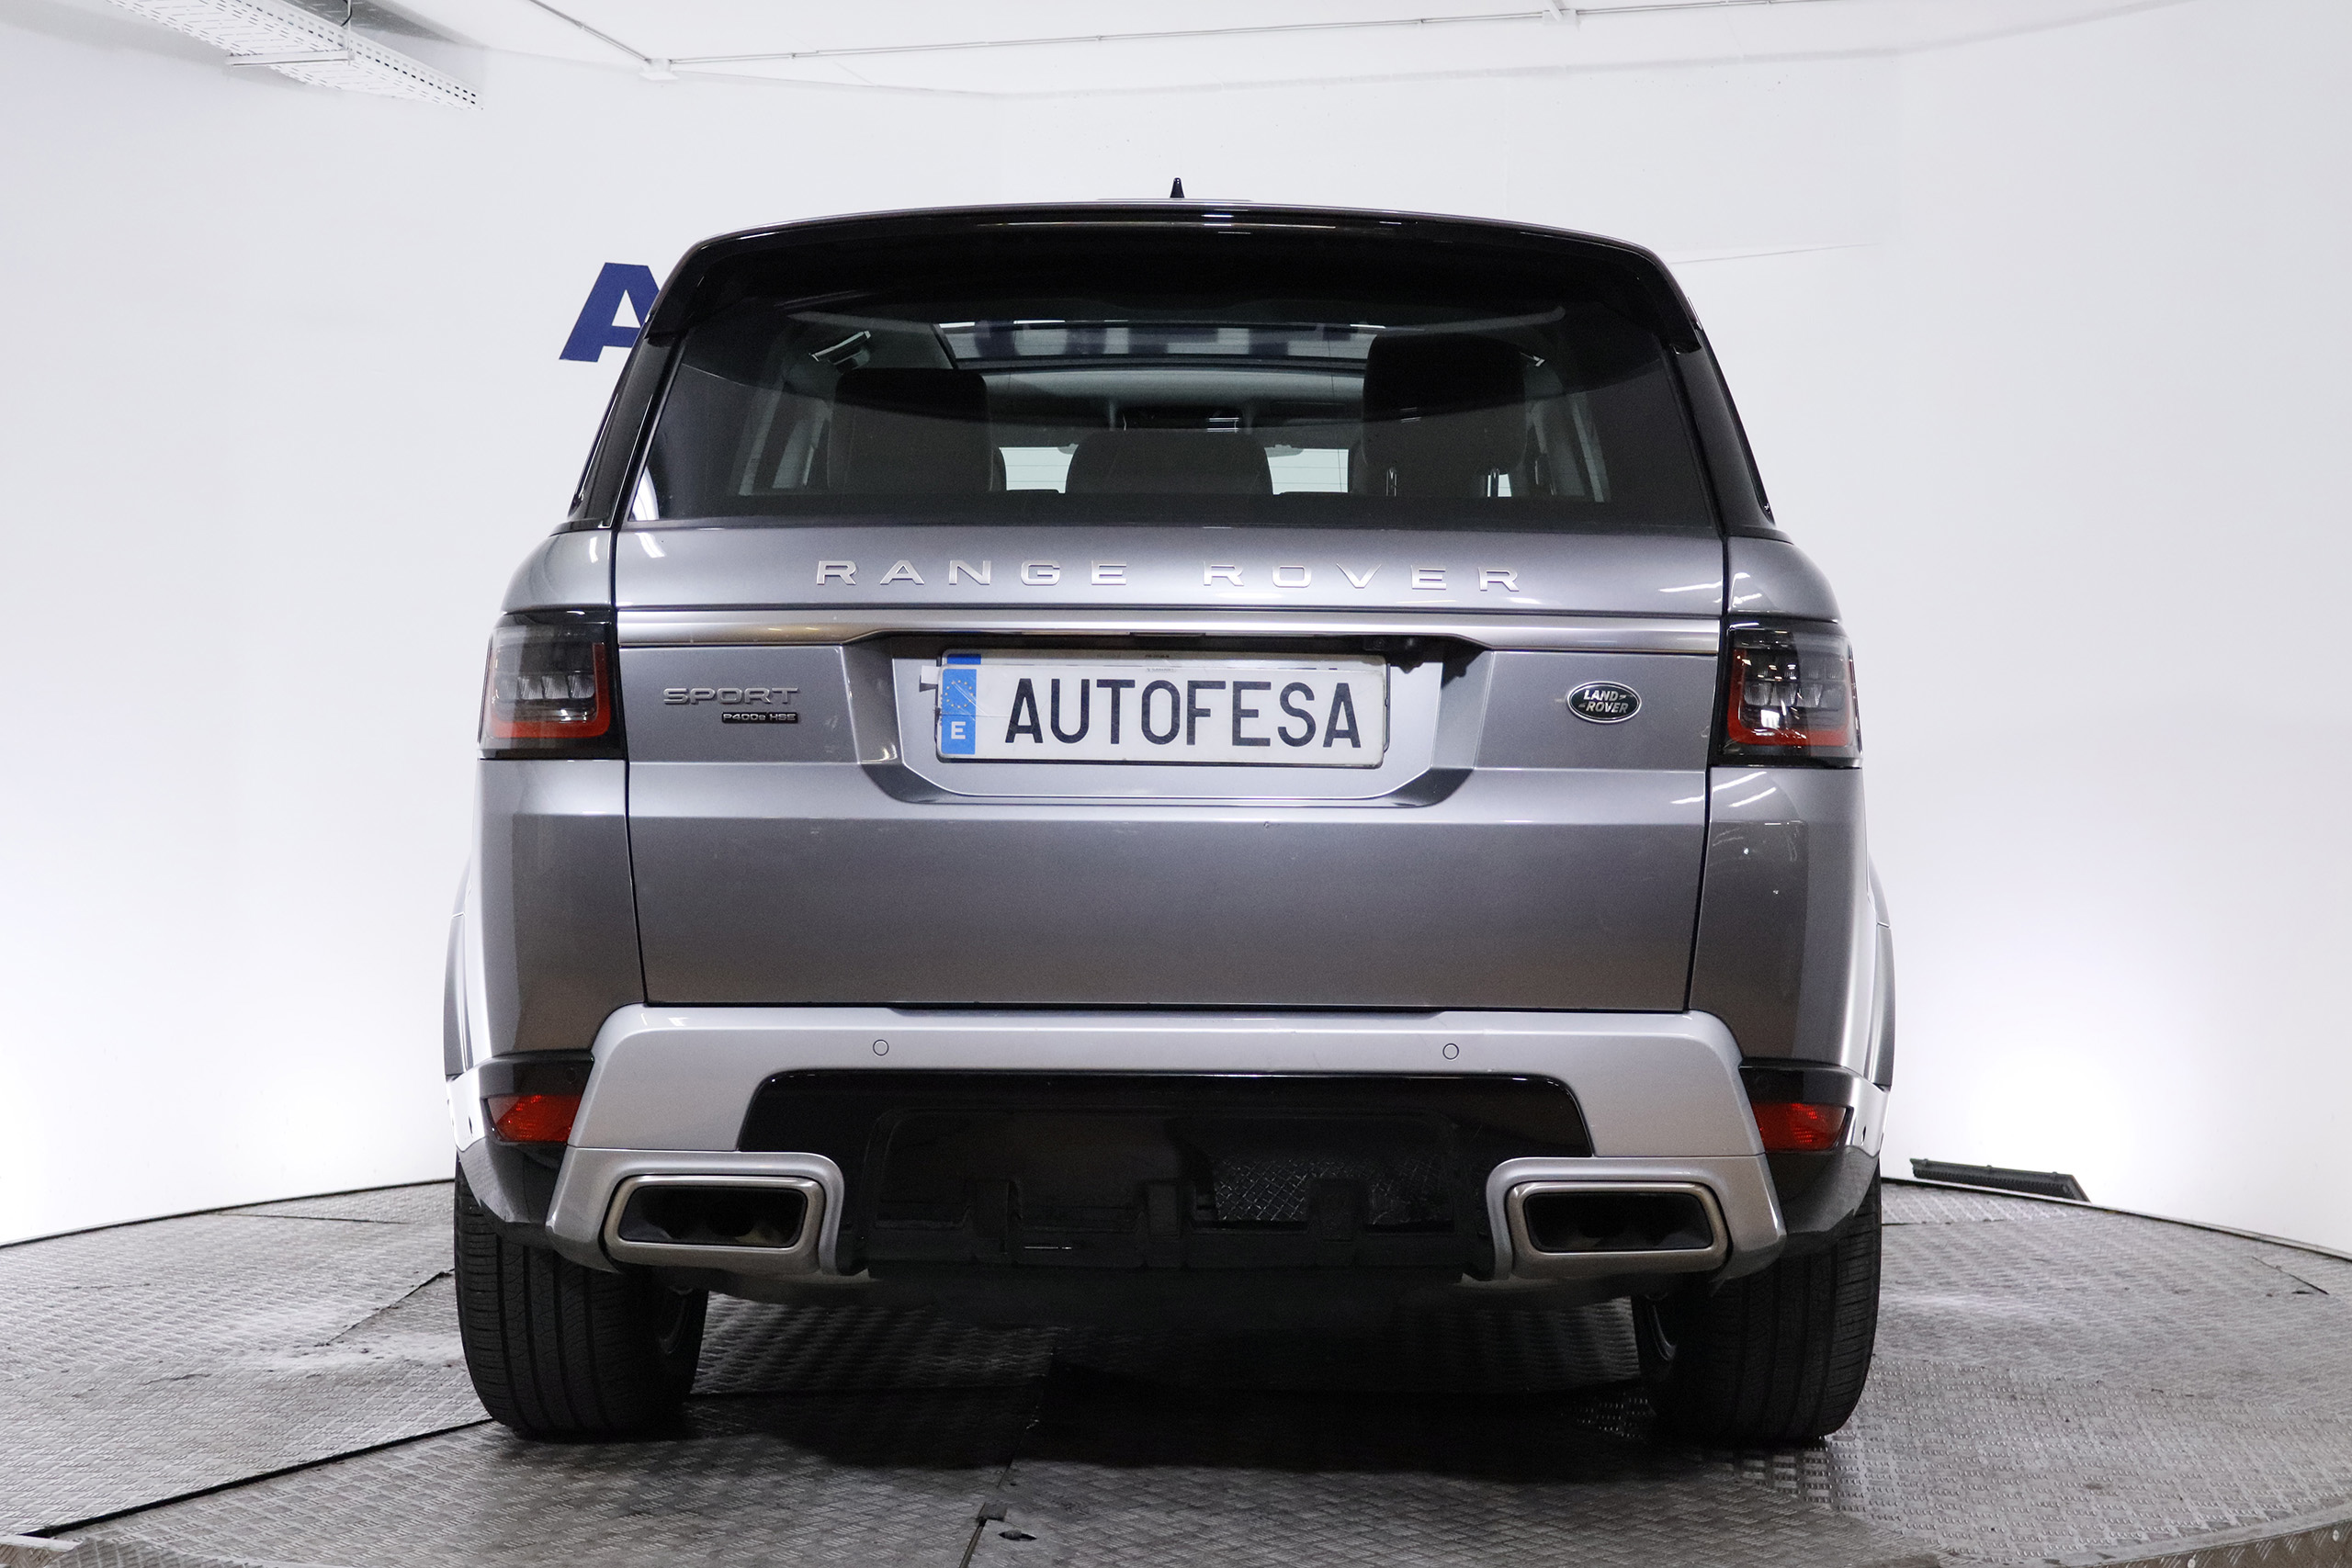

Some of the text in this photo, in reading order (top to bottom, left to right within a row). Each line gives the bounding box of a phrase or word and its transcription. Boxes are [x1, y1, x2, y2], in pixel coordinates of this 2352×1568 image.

[816, 559, 1520, 592] RANGE ROVER
[662, 687, 798, 705] SPORT
[1583, 690, 1619, 702] LAND
[1004, 678, 1362, 749] AUTOFESA
[1585, 701, 1629, 714] ROVER
[722, 713, 797, 722] P400e HSE
[951, 721, 967, 739] E
